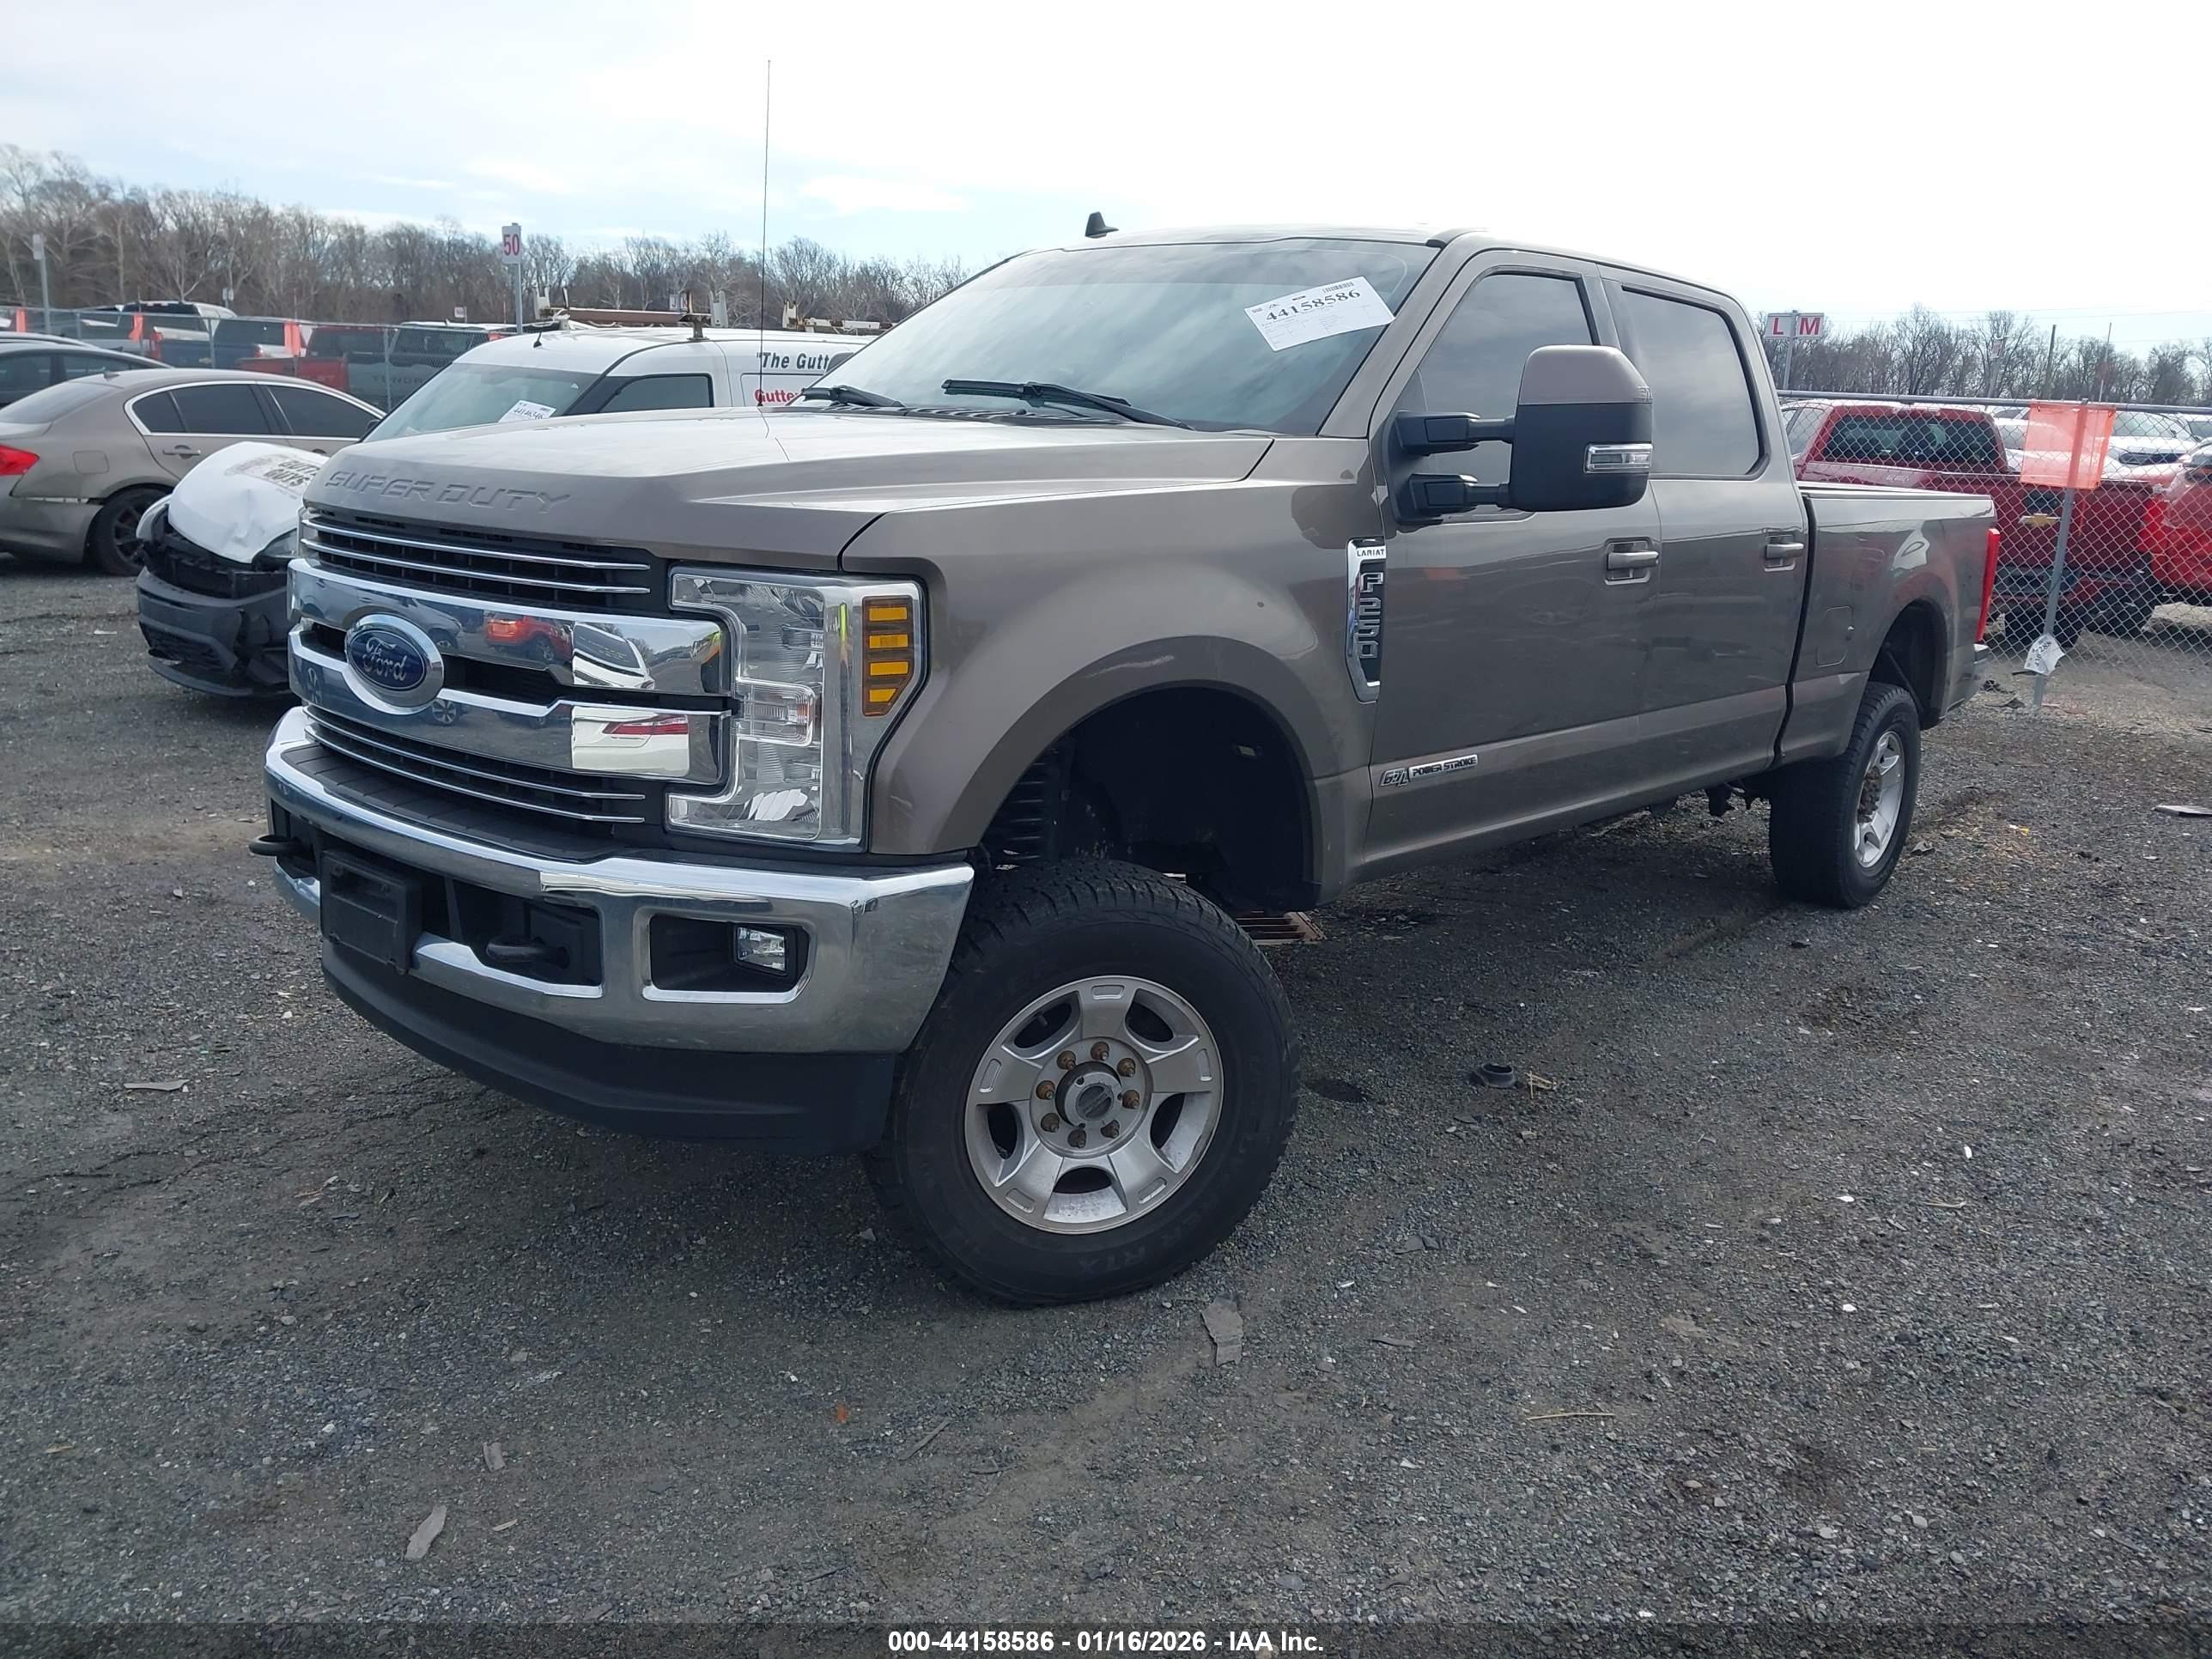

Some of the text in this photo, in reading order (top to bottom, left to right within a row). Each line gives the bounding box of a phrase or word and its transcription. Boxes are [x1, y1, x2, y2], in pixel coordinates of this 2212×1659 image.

[503, 233, 520, 256] 50
[1265, 289, 1361, 322] 44158586
[1772, 317, 1821, 335] L M
[755, 388, 799, 403] Gutte
[325, 471, 435, 502] SUPER
[435, 483, 572, 514] DUTY
[1356, 548, 1385, 558] LARIAT
[362, 636, 408, 682] Ford
[1412, 763, 1443, 777] POWER
[1443, 756, 1477, 770] STROKE
